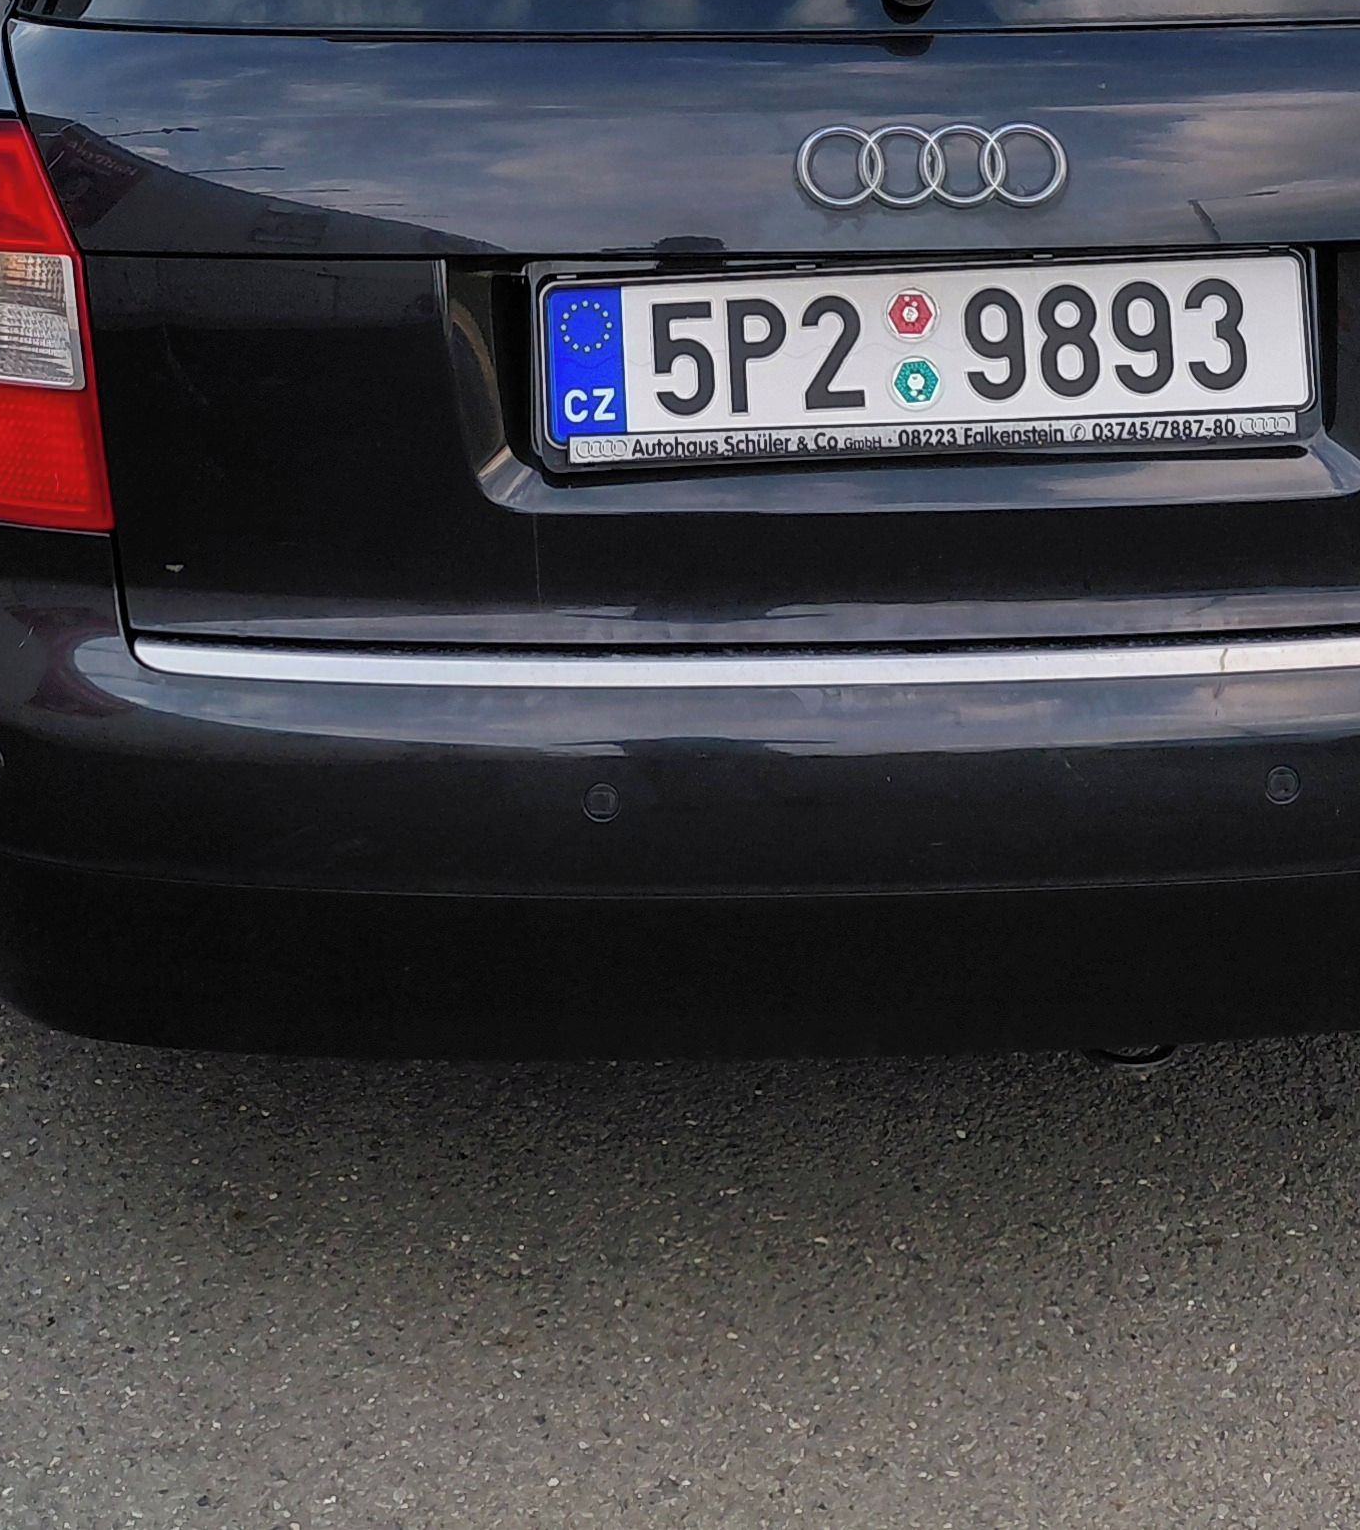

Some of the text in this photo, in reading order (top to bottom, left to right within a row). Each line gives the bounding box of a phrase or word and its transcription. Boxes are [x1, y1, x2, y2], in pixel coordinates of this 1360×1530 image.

[652, 278, 1248, 416] 5P2 9893
[564, 387, 616, 423] CZ
[631, 418, 1235, 457] Autohaus Schüler & Co GmbH 08223 Falkenstein 03745/7887-80
